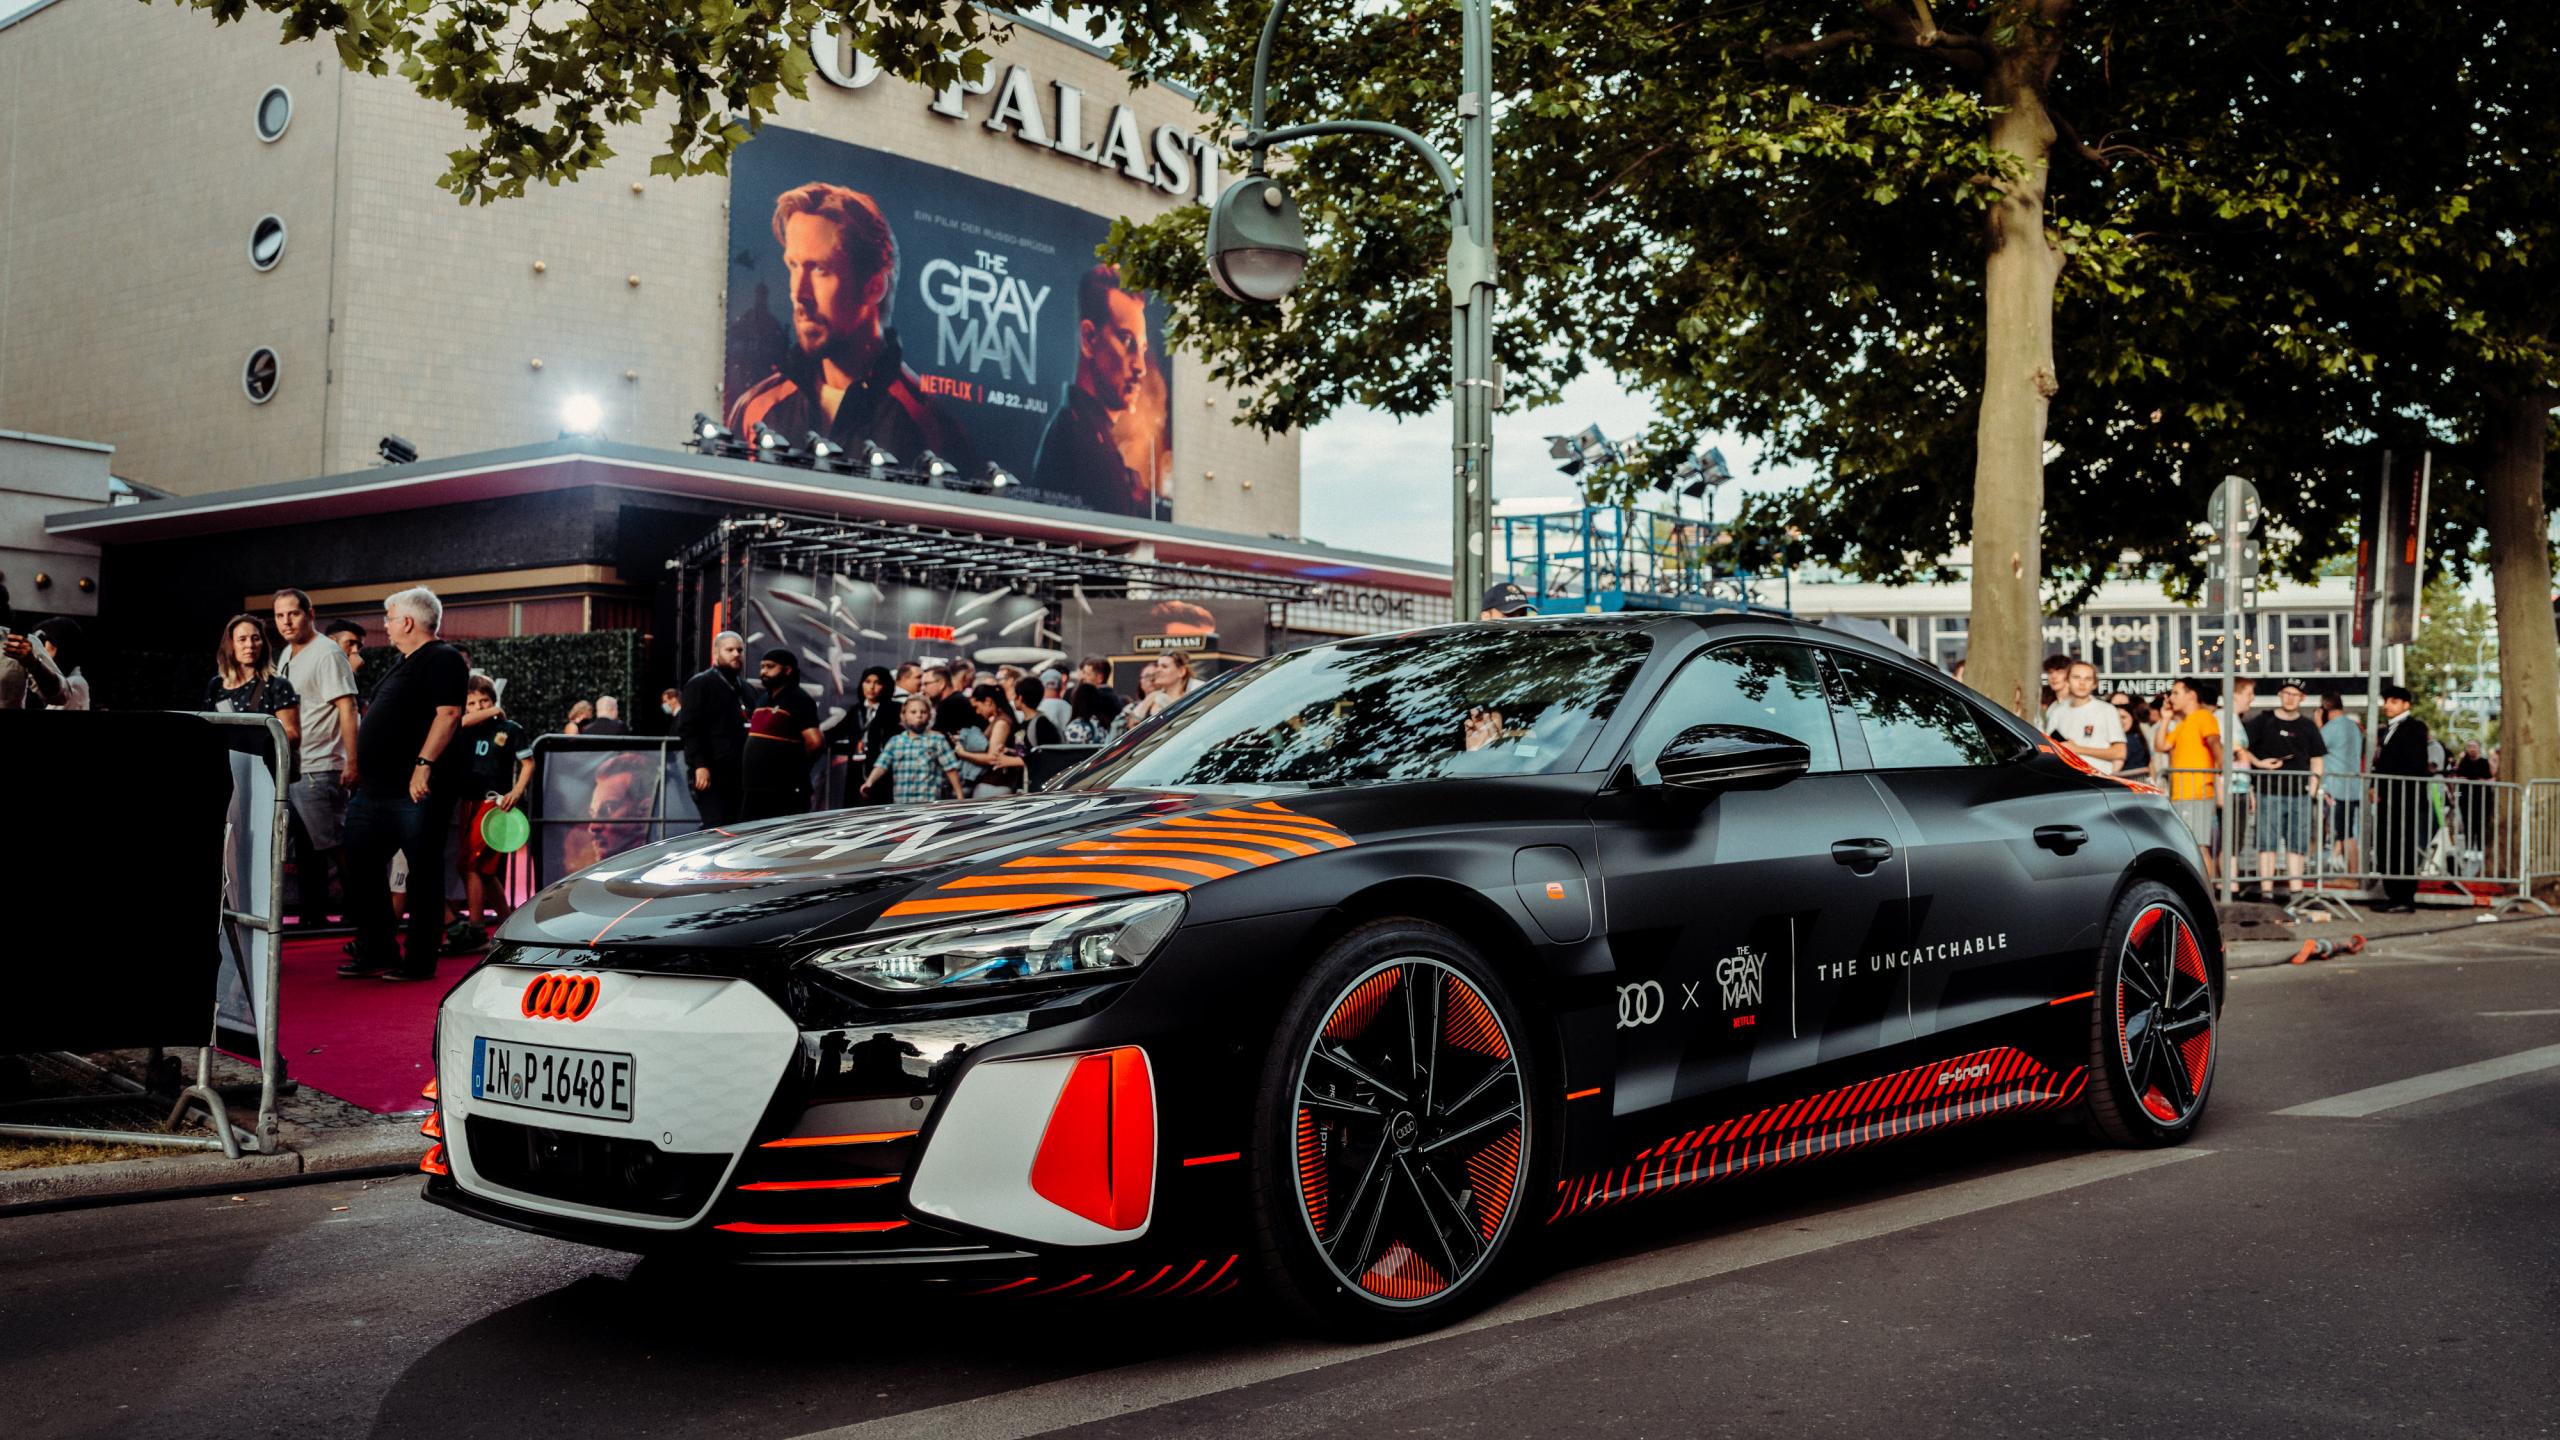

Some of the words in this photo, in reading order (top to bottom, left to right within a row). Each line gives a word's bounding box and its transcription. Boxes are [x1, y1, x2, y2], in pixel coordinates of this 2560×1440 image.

[931, 48, 1222, 209] PALAST
[934, 214, 959, 229] FILM
[975, 249, 1009, 275] THE
[919, 258, 1051, 334] GRAY
[937, 314, 1037, 385] MAN
[919, 374, 973, 401] NETFLIX
[987, 390, 1005, 405] AB
[1024, 397, 1048, 413] JULI
[1314, 588, 1414, 620] WELCOME
[475, 740, 489, 756] 10
[1736, 945, 1750, 956] THE
[1817, 959, 1857, 981] THE
[1871, 933, 2007, 971] UNCATCHABLE
[1716, 952, 1768, 986] GRAY
[1722, 979, 1762, 1011] MAN
[1732, 1014, 1756, 1029] NETFLIX
[486, 1047, 510, 1096] IN
[1938, 1063, 1990, 1086] e-tron
